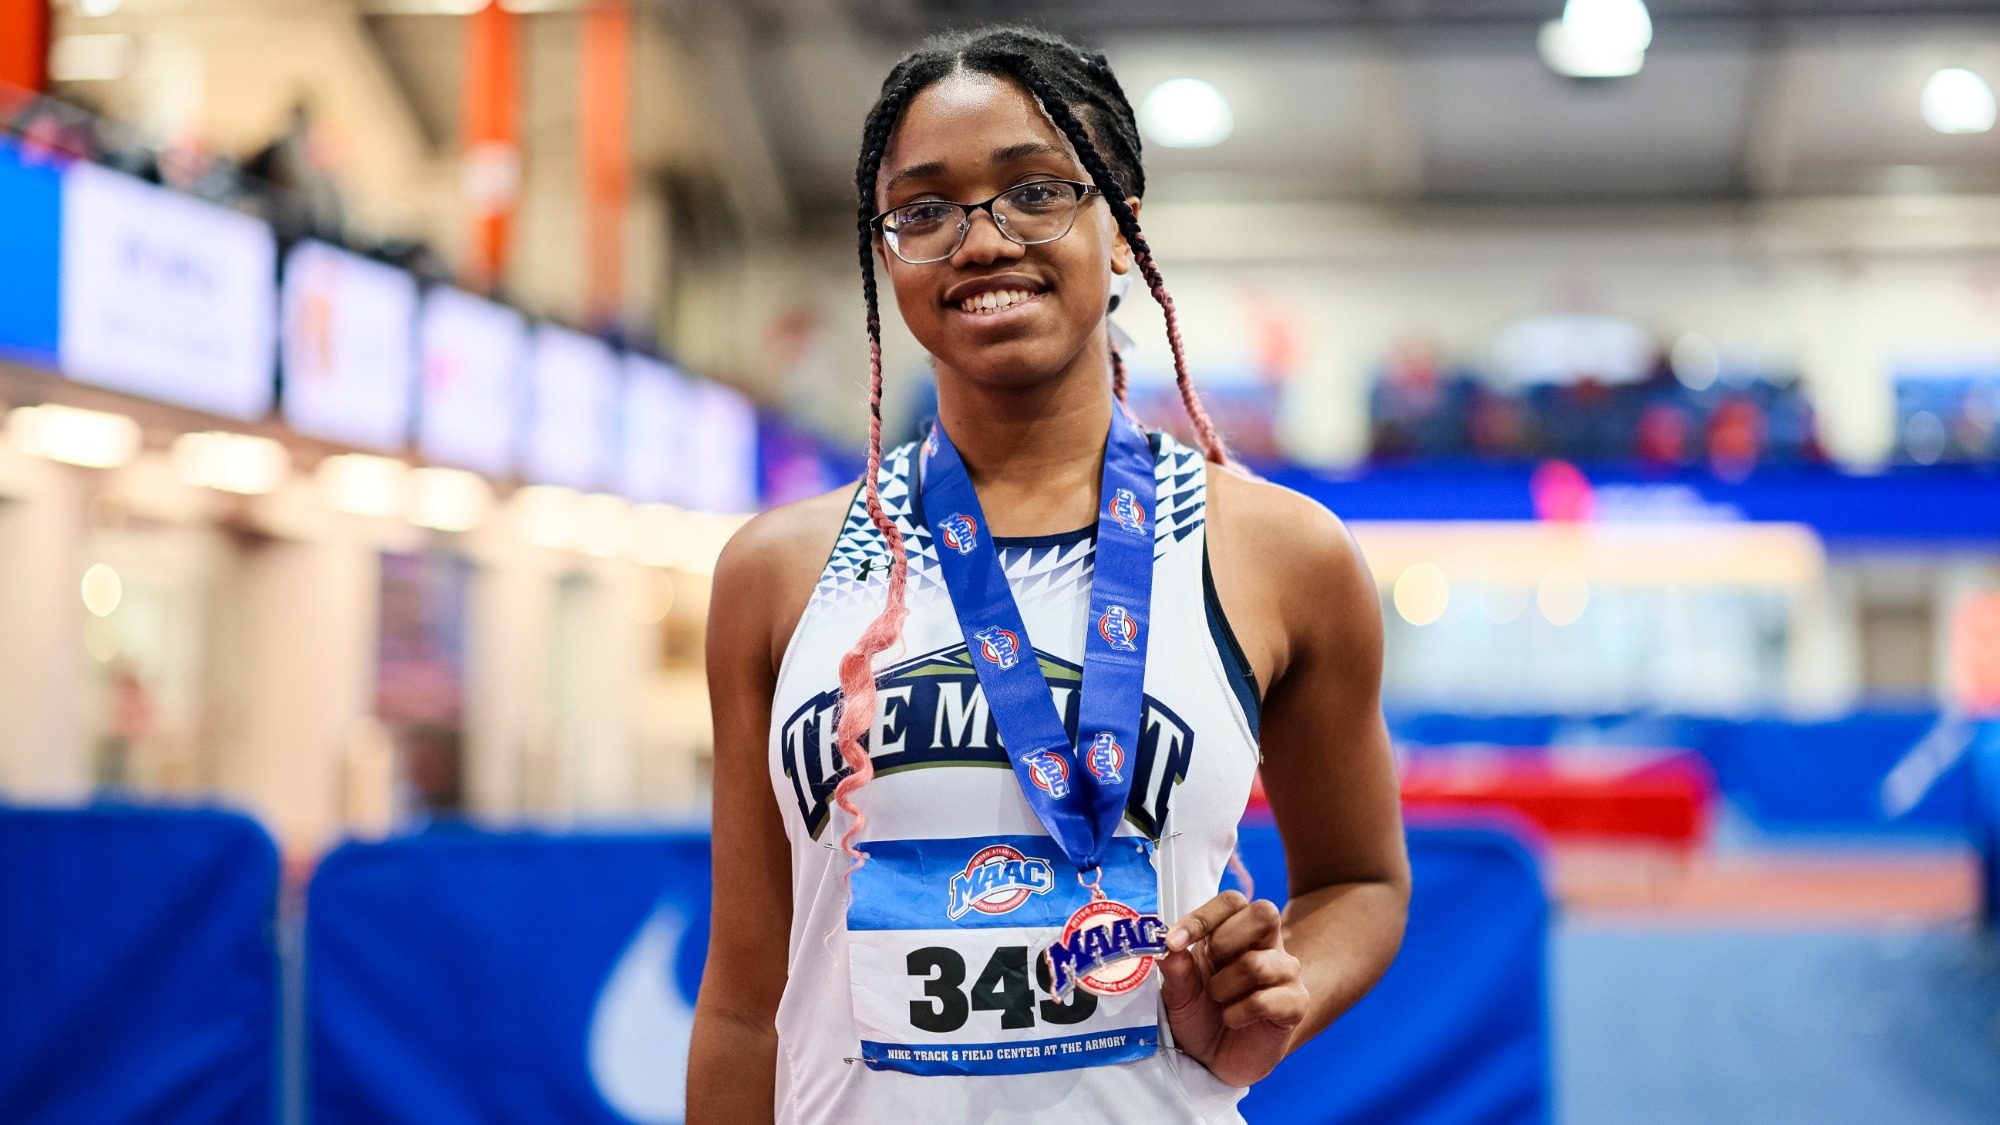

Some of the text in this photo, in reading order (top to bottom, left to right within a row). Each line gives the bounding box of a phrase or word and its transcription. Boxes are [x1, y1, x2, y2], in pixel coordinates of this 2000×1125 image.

[939, 513, 976, 553] MAAC
[1116, 489, 1146, 535] MAAC
[976, 626, 1017, 668] MAAC
[1107, 606, 1136, 650] MAAC
[1022, 748, 1068, 798] MAAC
[1095, 732, 1122, 783] MAAC
[992, 848, 1017, 859] ATLANTIC
[949, 859, 1050, 917] MAAC
[1048, 916, 1168, 994] MAAC
[888, 1035, 1127, 1062] NIKE TRACK & FIELD CENTER AT THE ARMORY
